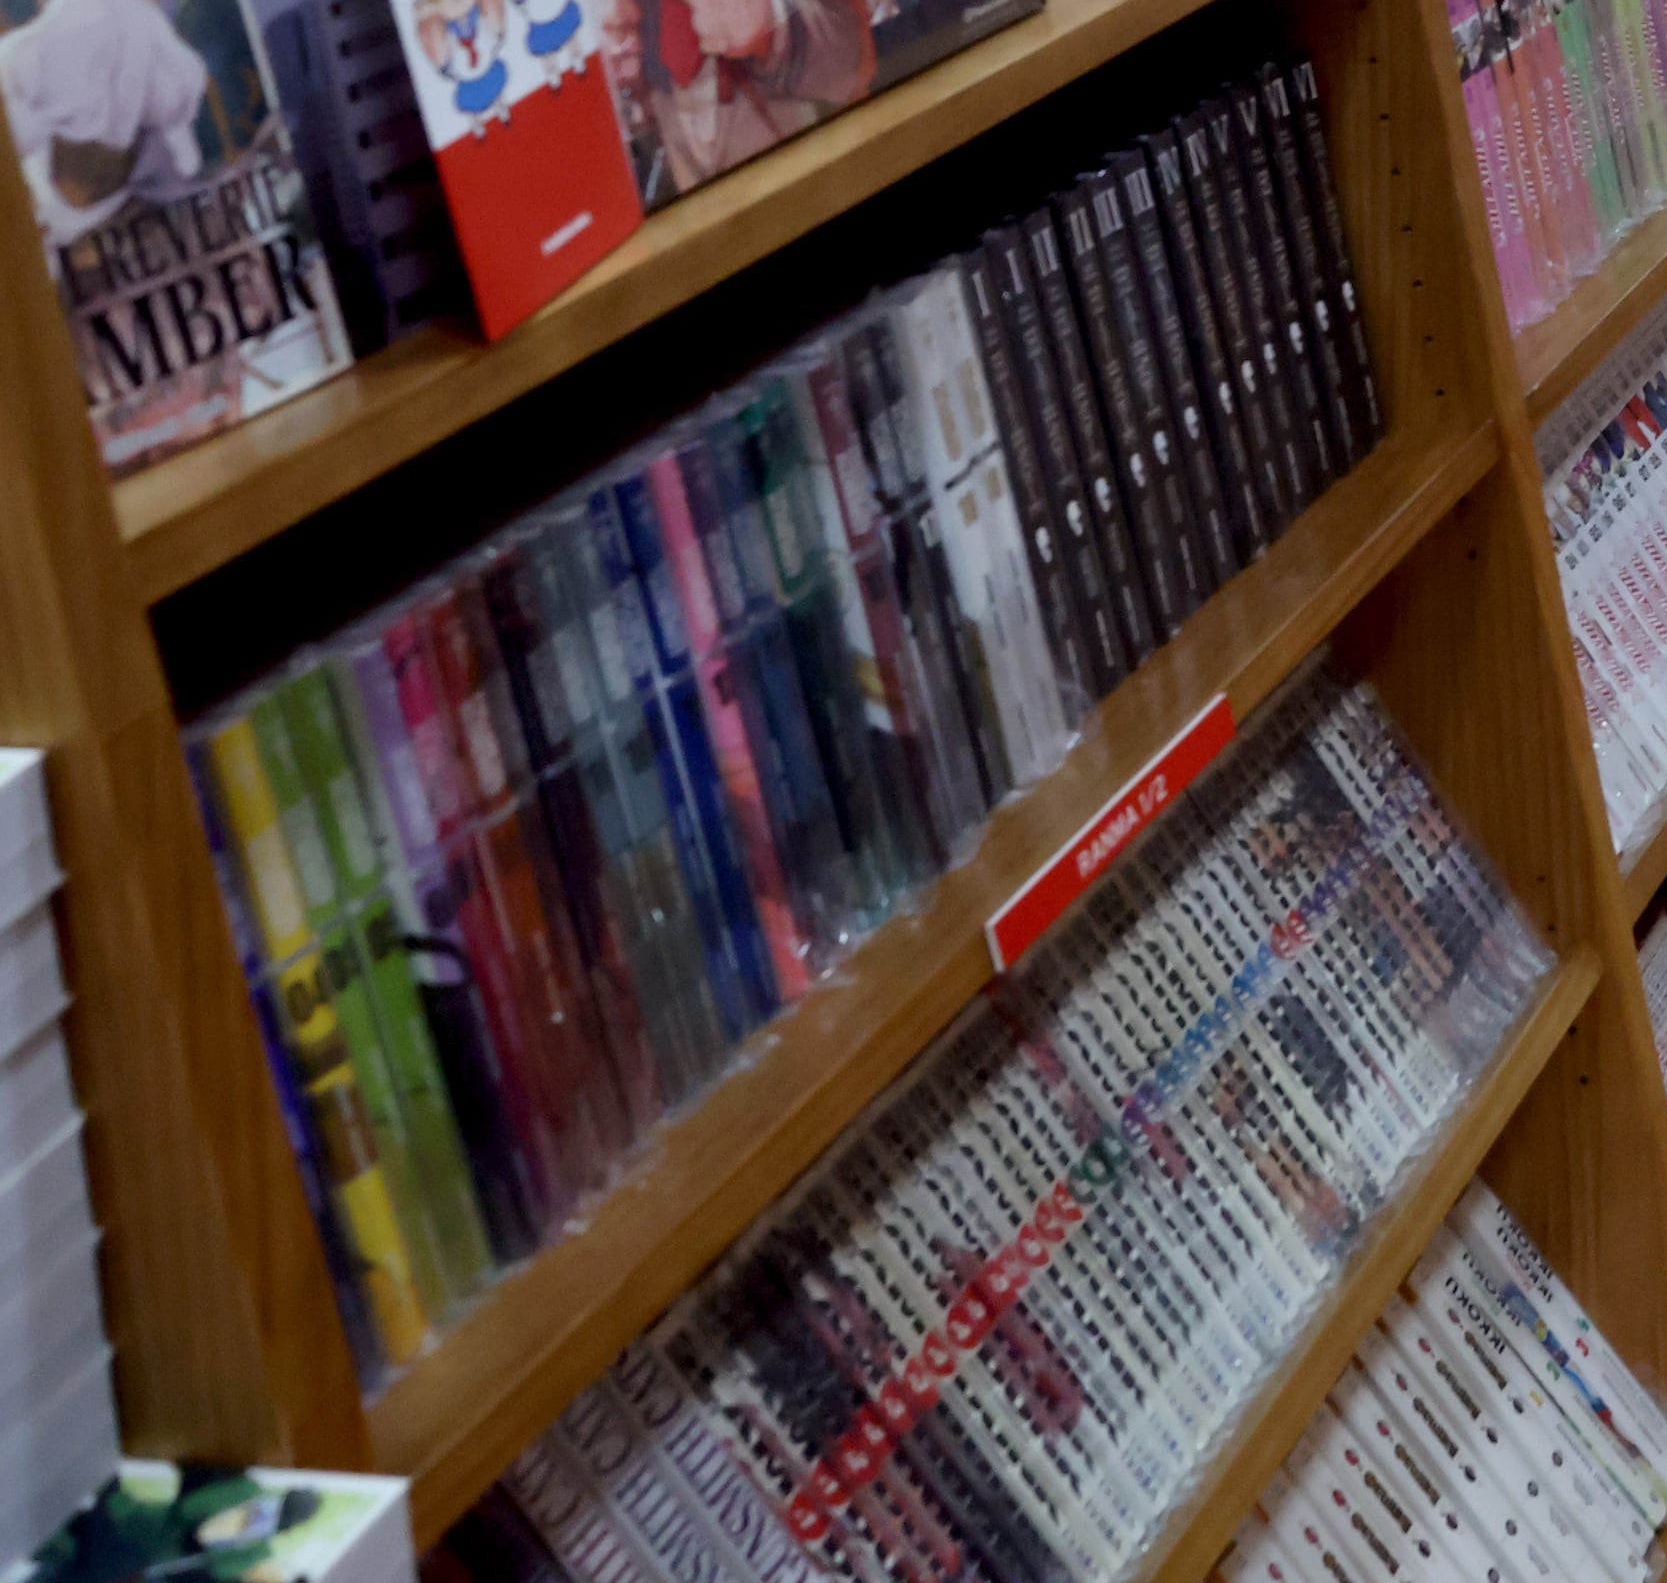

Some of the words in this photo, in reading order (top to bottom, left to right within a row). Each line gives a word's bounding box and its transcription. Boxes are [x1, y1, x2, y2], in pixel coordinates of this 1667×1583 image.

[84, 239, 316, 401] MBER
[1075, 806, 1142, 881] RANMA
[1138, 773, 1171, 820] 1/2
